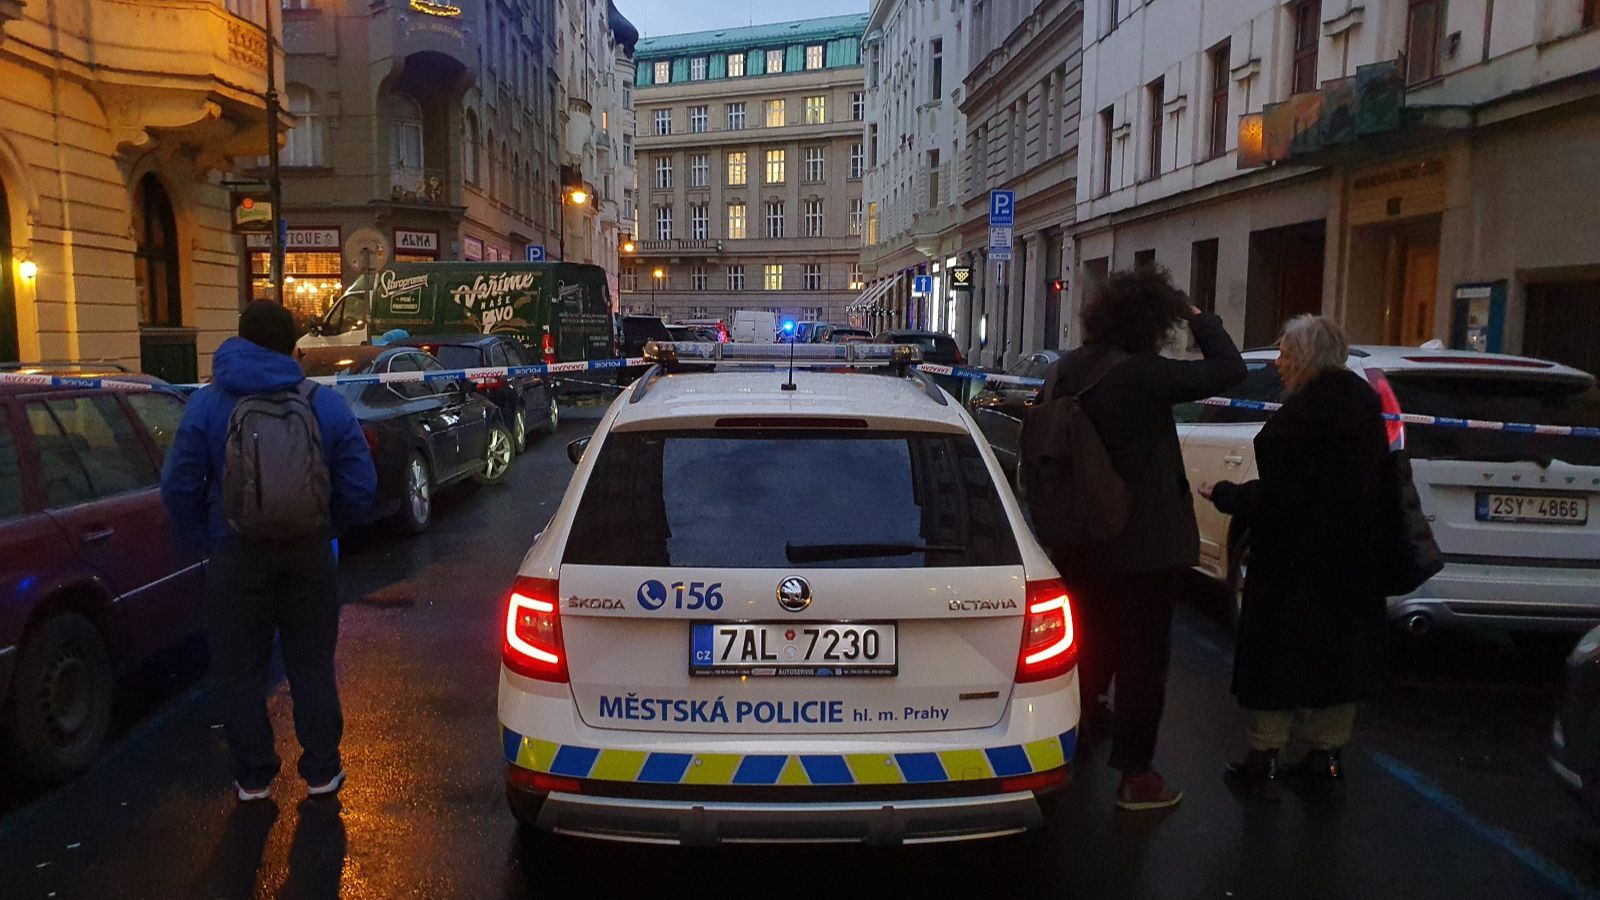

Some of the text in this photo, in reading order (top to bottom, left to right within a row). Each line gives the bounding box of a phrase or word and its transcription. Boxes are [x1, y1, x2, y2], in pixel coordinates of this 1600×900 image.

[995, 194, 1009, 214] P
[264, 231, 321, 245] AIQUE
[402, 233, 431, 247] ALMA
[530, 248, 541, 262] P
[481, 296, 511, 310] NAŠE
[1493, 499, 1578, 518] 2SY 4866
[568, 595, 626, 609] ŠKODA
[671, 581, 724, 611] 156
[949, 599, 1017, 611] OCTAVIA
[720, 629, 879, 660] 7AL 7230
[696, 650, 711, 660] CZ
[778, 668, 815, 676] AUTOSERVIS
[599, 692, 950, 723] MĚSTSKÁ POLICIE hl. m. Prahy
